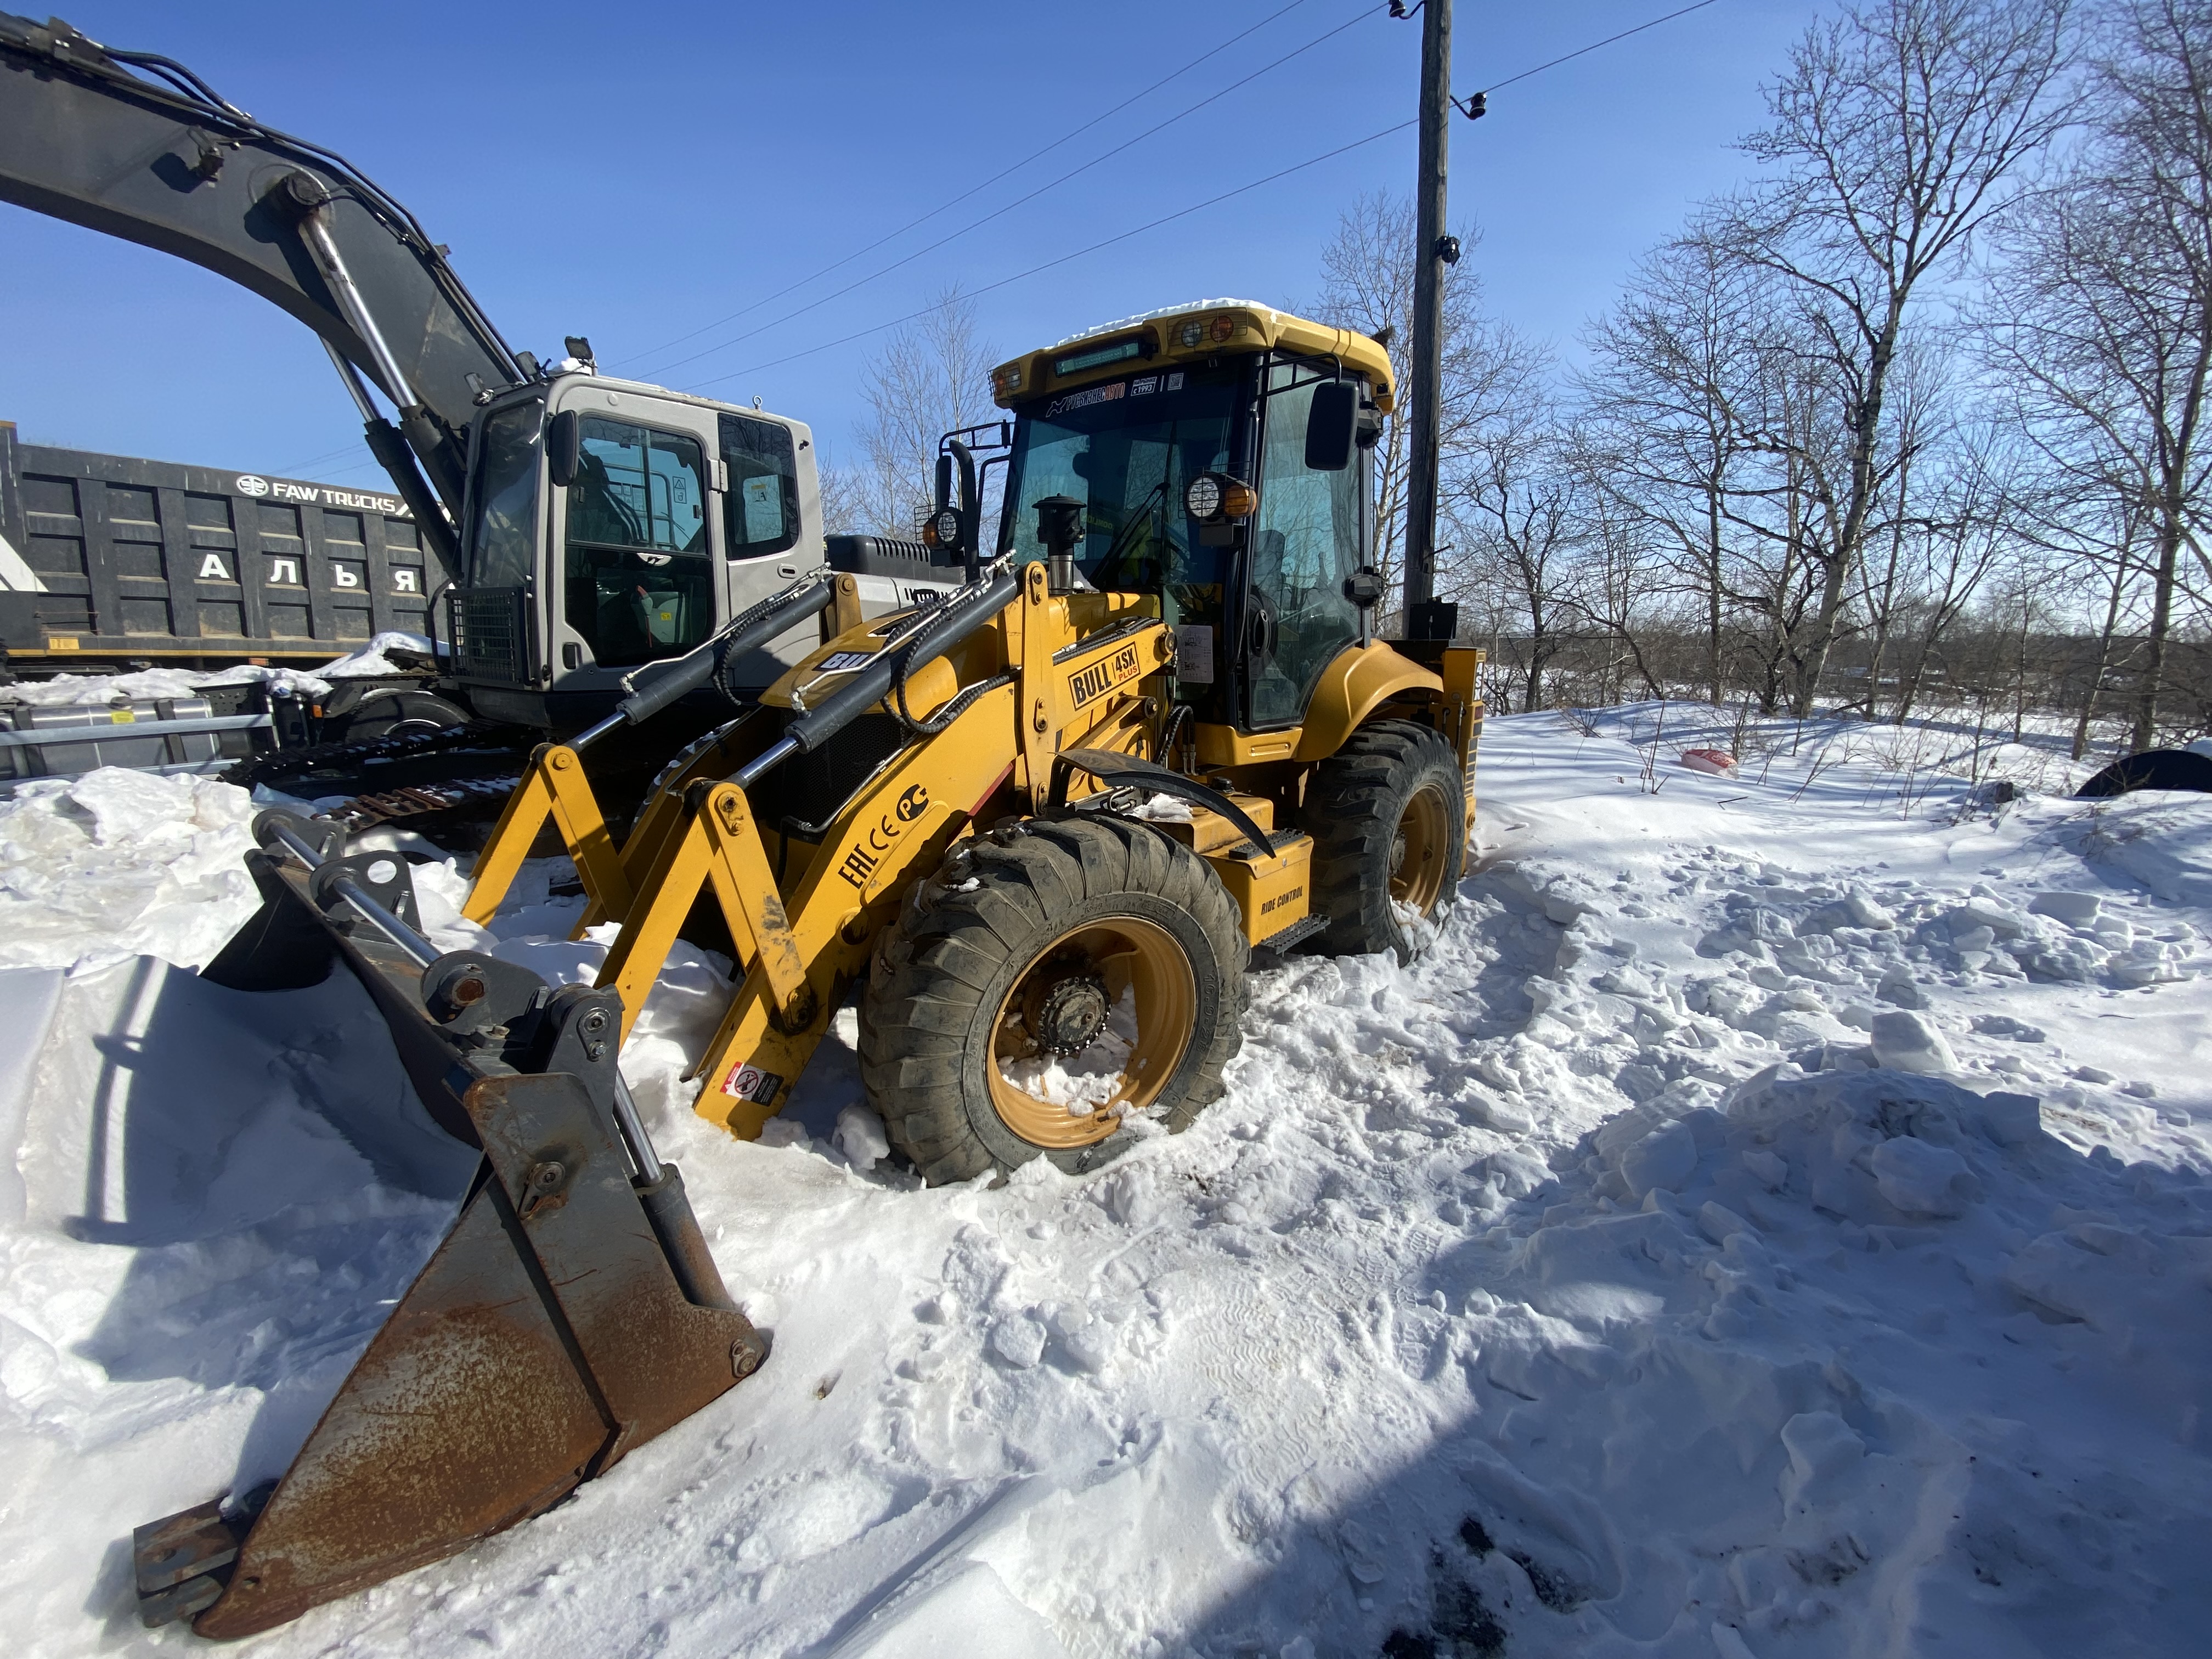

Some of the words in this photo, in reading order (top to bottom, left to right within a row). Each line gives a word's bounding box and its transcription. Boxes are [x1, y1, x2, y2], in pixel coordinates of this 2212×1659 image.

[1138, 384, 1153, 393] 1993
[273, 482, 319, 501] FAW
[322, 489, 396, 512] TRUCKS
[1073, 662, 1113, 704] BULL
[1115, 648, 1136, 673] 4SX
[1118, 665, 1138, 681] PLUS
[1260, 898, 1276, 916] RIDE
[1277, 885, 1303, 908] CONTROL
